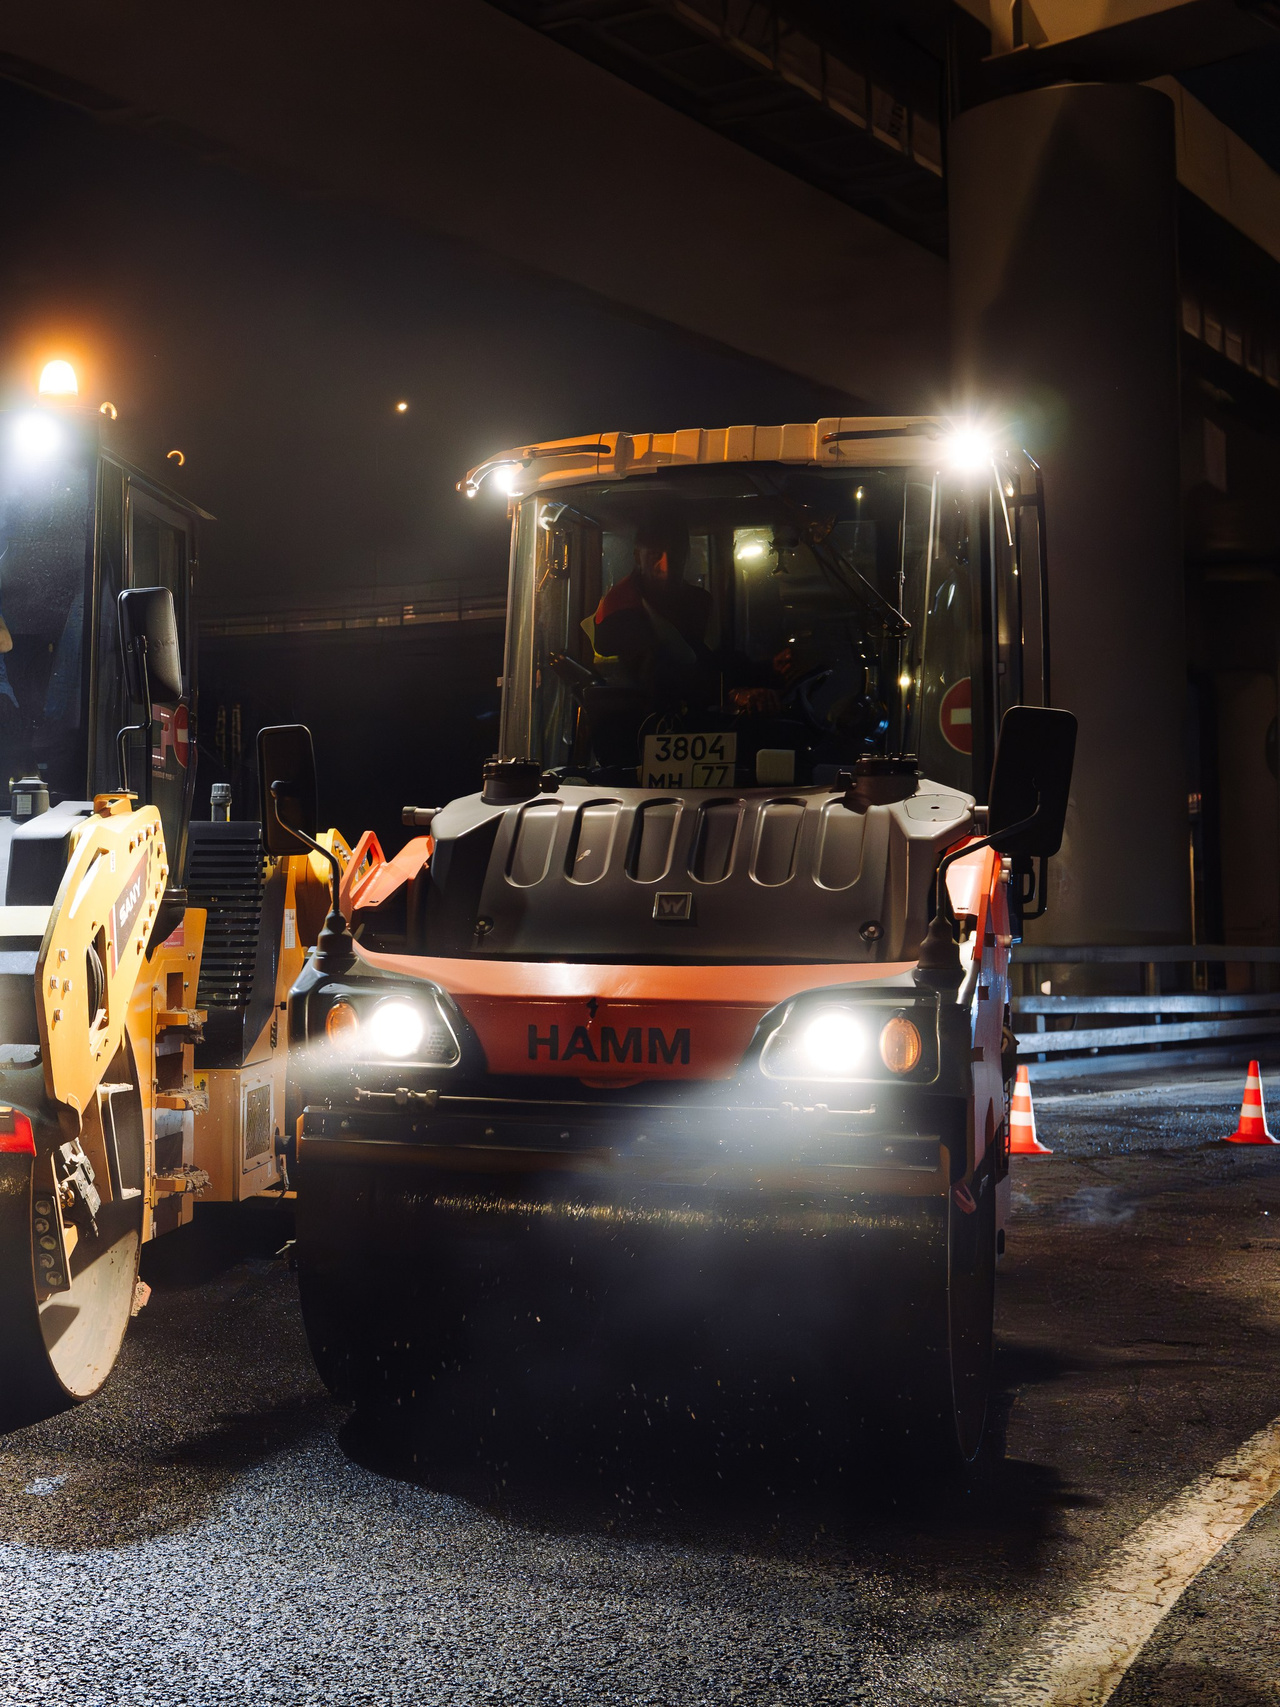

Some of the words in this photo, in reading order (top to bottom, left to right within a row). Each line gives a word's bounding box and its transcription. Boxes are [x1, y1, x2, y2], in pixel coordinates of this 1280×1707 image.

[656, 735, 725, 761] 3804
[702, 766, 729, 786] 77
[120, 877, 141, 927] SANY
[528, 1024, 690, 1065] HAMM
